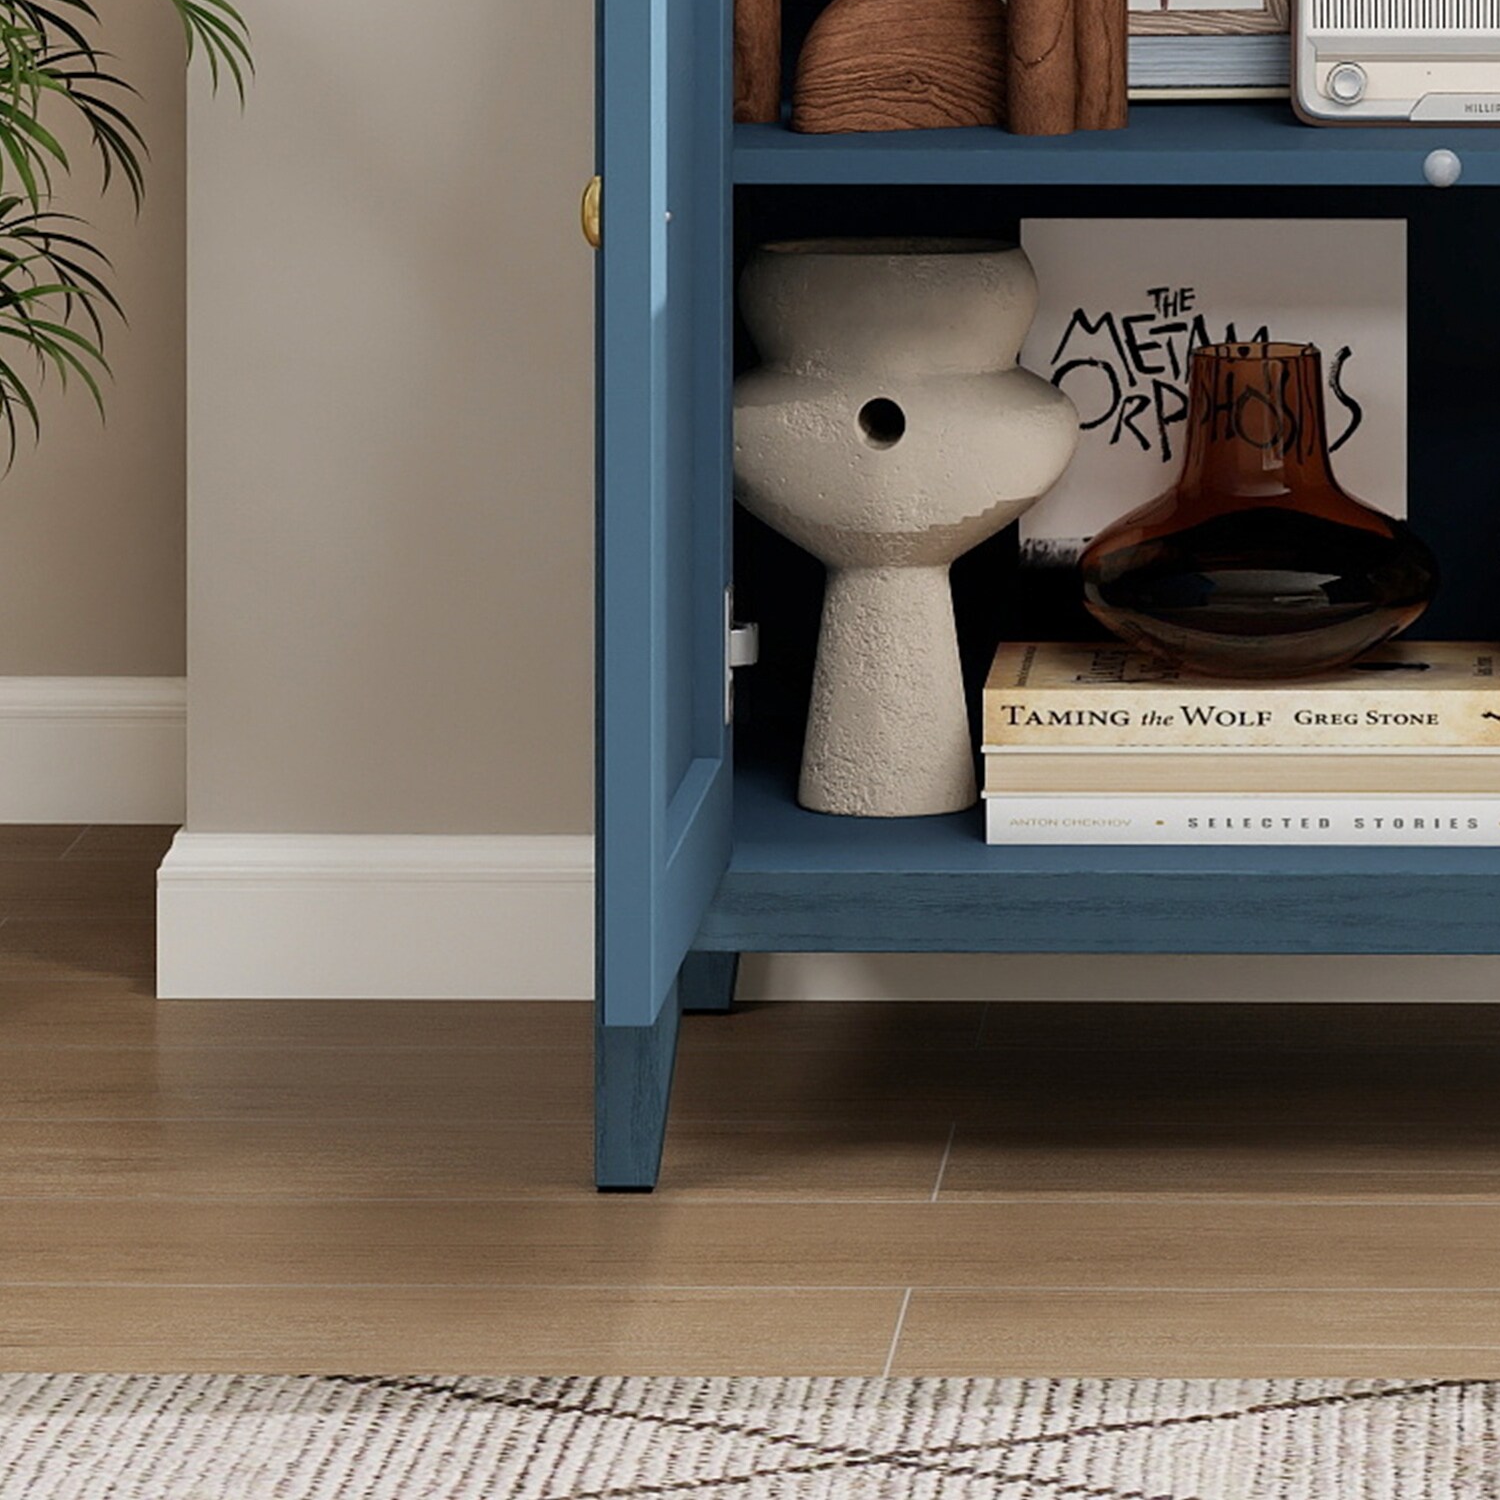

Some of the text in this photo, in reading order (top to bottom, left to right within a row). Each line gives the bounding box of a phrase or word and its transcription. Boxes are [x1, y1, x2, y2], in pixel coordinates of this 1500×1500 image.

[1147, 287, 1196, 318] THE
[1140, 710, 1174, 726] the
[1009, 817, 1479, 829] ANTON CHEKHOV SELECTED STORIES
